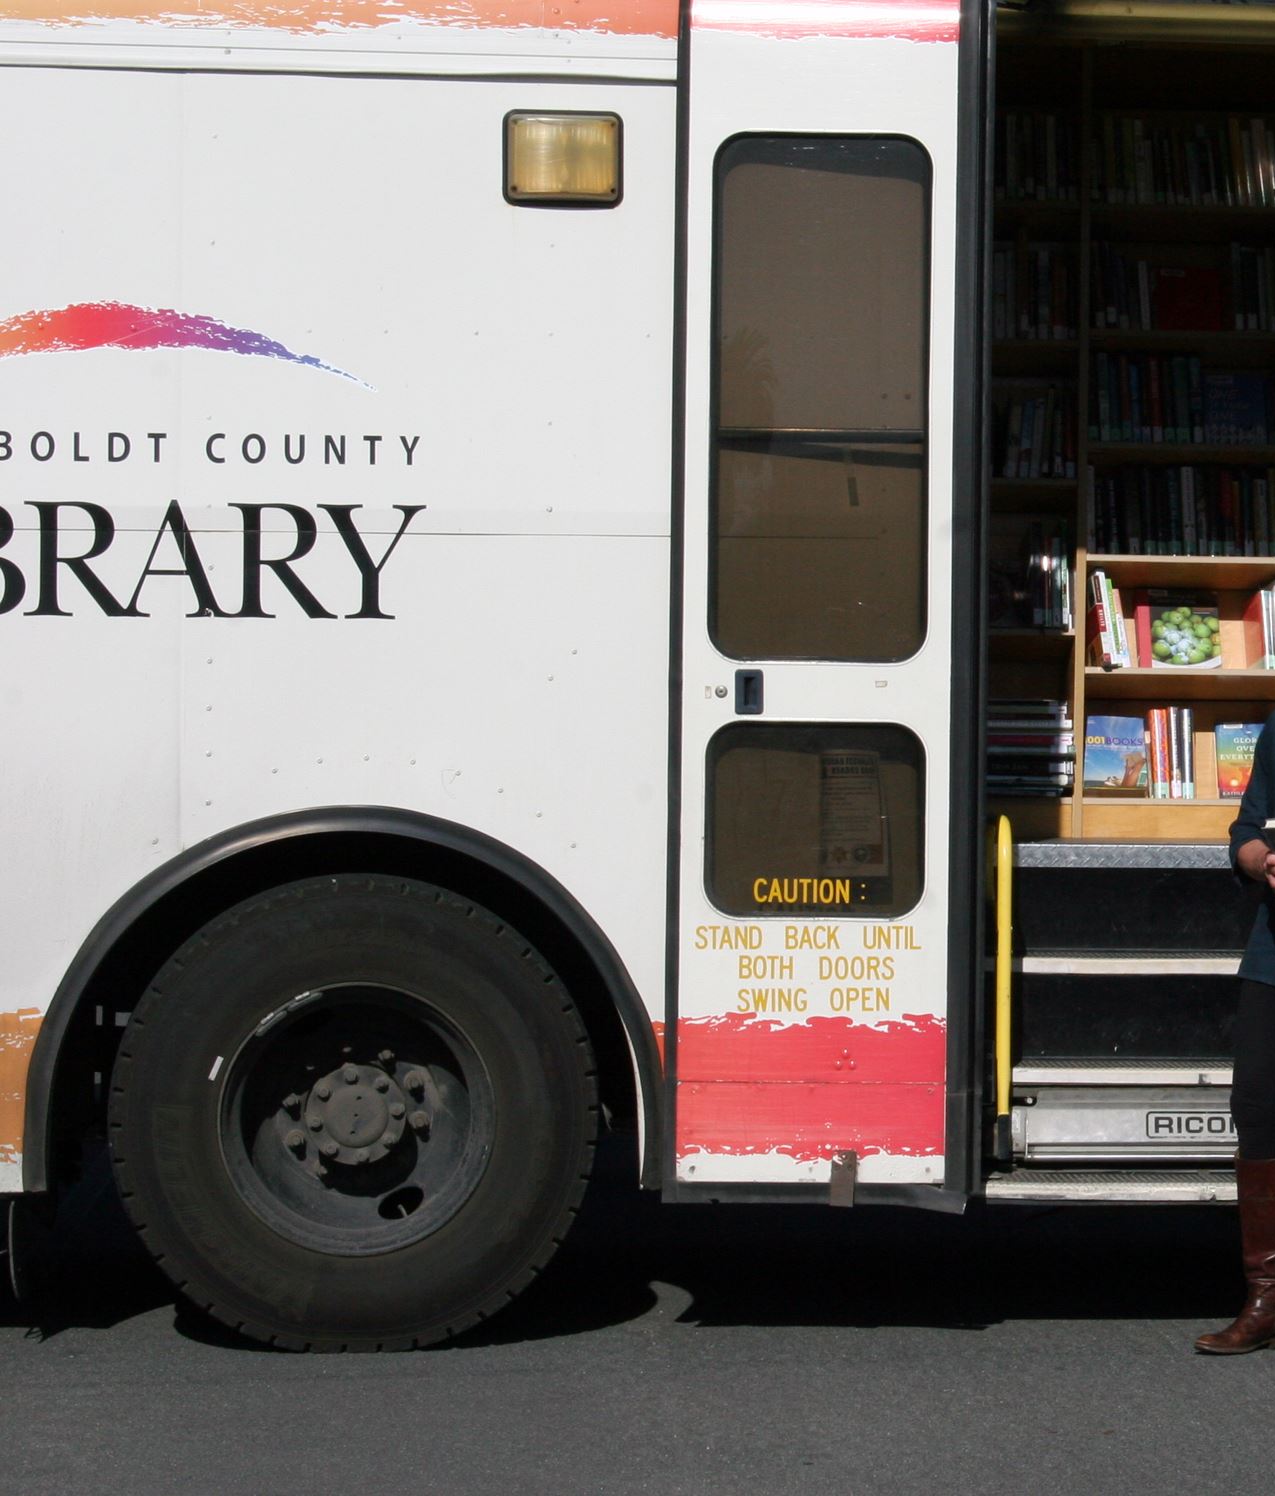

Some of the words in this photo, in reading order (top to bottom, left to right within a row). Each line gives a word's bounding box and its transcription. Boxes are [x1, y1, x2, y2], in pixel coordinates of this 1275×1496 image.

[205, 433, 421, 465] COUNTY
[753, 878, 850, 904] CAUTION
[695, 926, 763, 950] STAND
[785, 926, 840, 950] BACK
[862, 926, 922, 950] UNTIL
[738, 955, 794, 979] BOTH
[819, 956, 895, 980] DOORS
[737, 988, 808, 1013] SWING
[830, 988, 890, 1012] OPEN
